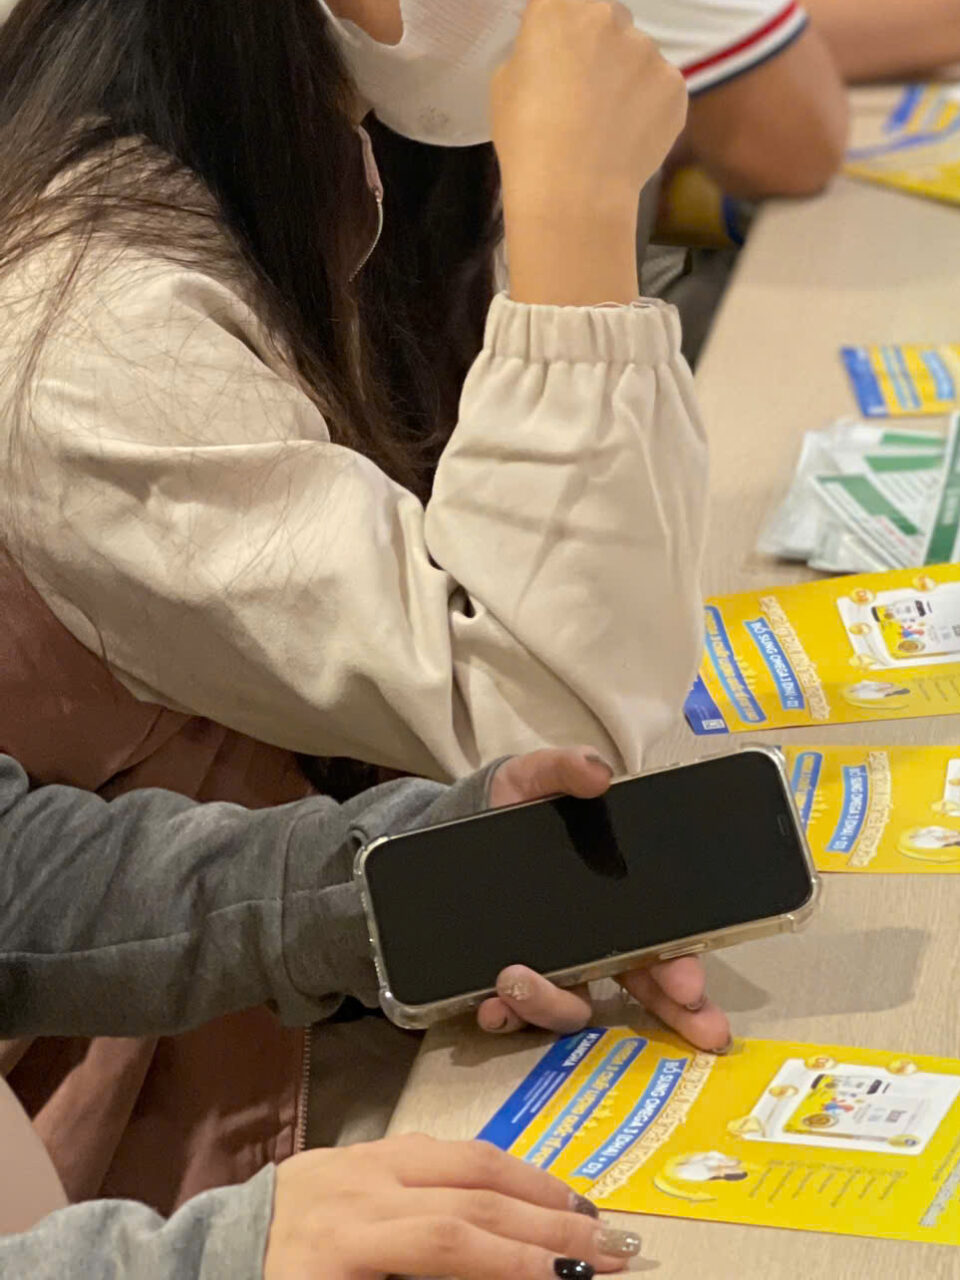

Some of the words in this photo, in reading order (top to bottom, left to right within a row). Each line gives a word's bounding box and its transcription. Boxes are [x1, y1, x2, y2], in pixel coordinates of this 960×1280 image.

[759, 633, 778, 655] SUNG
[650, 1074, 674, 1098] SUNG
[633, 1098, 661, 1128] OMEGA
